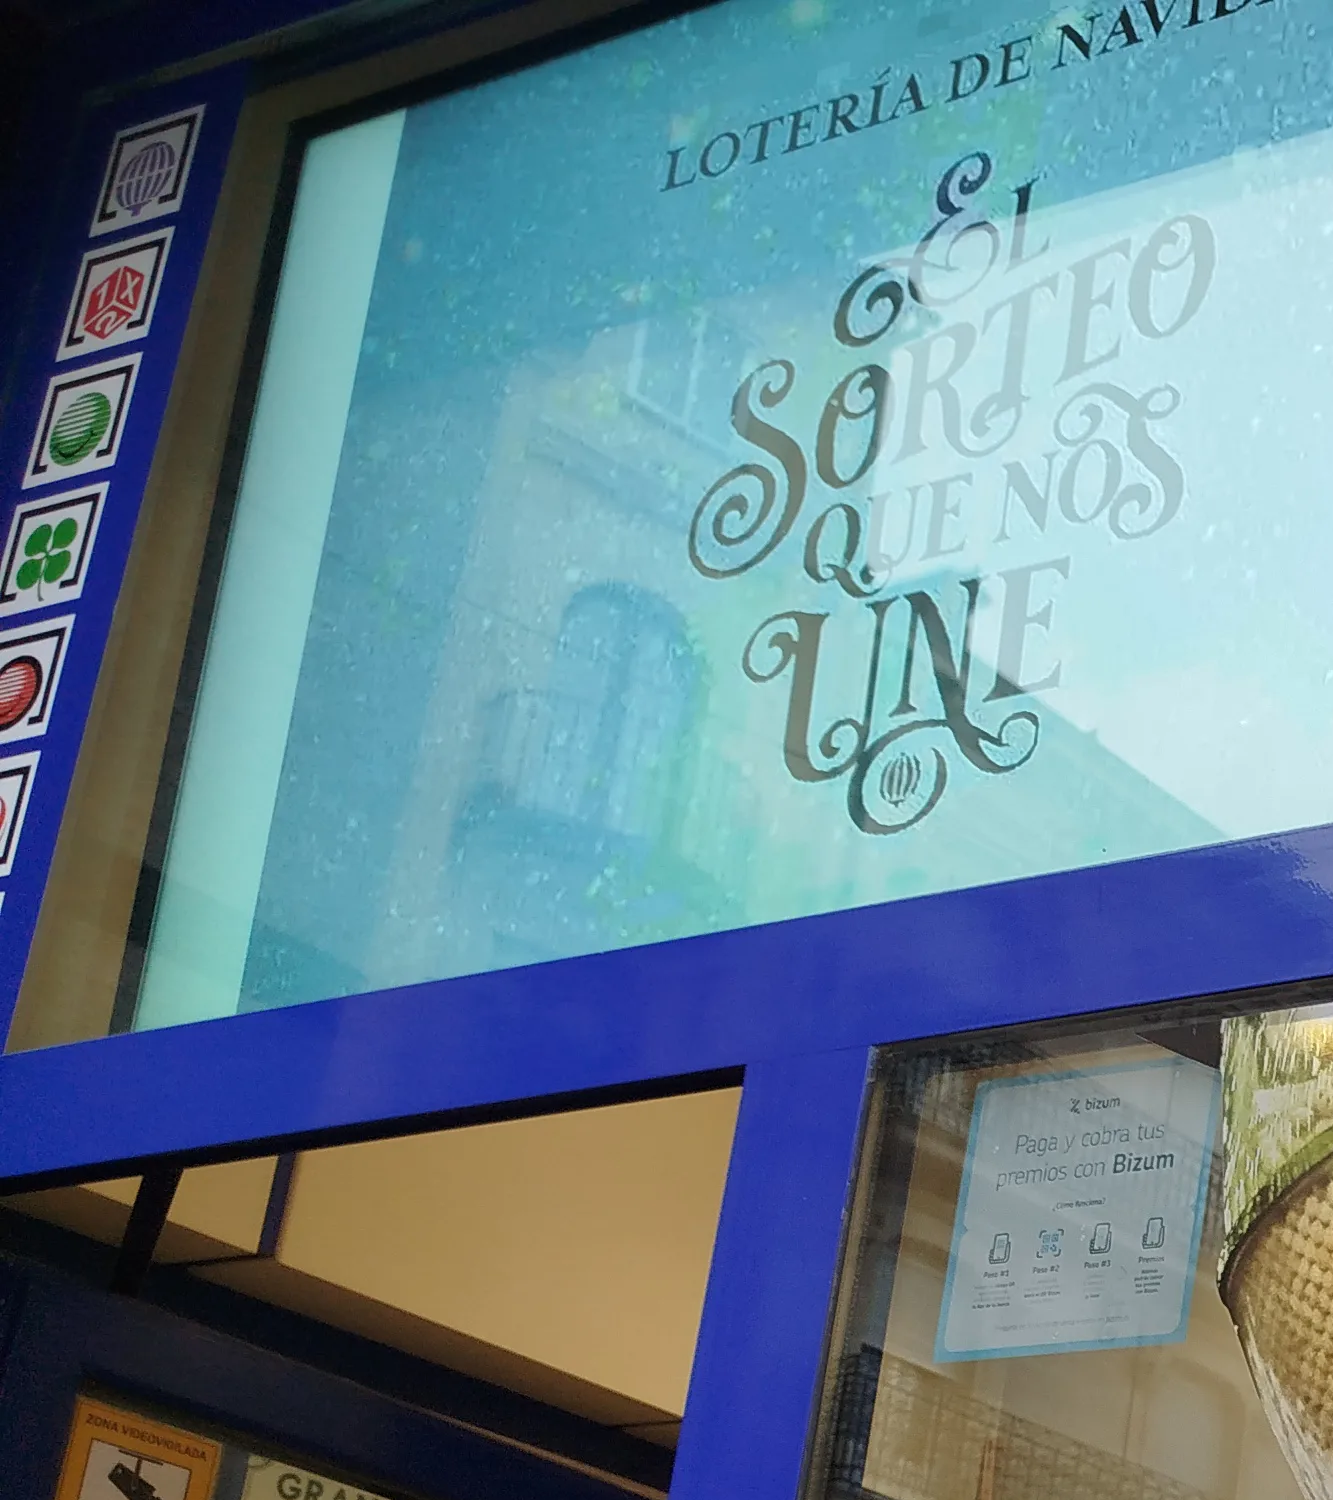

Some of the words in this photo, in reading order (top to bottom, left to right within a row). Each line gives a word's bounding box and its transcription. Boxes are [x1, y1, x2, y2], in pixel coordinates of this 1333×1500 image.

[658, 67, 929, 194] LOTERÍA
[946, 36, 1034, 103] DE
[1050, 0, 1275, 70] NAVI
[834, 150, 1050, 347] EL
[687, 214, 1217, 579] SORTEO
[804, 472, 975, 599] QUE
[992, 383, 1186, 544] NOS
[742, 556, 1071, 835] UNE
[996, 1162, 1068, 1192] premios
[1073, 1160, 1106, 1179] con
[1112, 1152, 1175, 1174] Bizum
[1015, 1134, 1059, 1157] Paga
[1064, 1134, 1076, 1154] y
[1081, 1126, 1130, 1148] cobra
[1137, 1123, 1165, 1142] tus
[1085, 1097, 1121, 1112] bizum
[86, 1413, 119, 1434] ZONA
[122, 1424, 208, 1461] VIDEOVIGILADA
